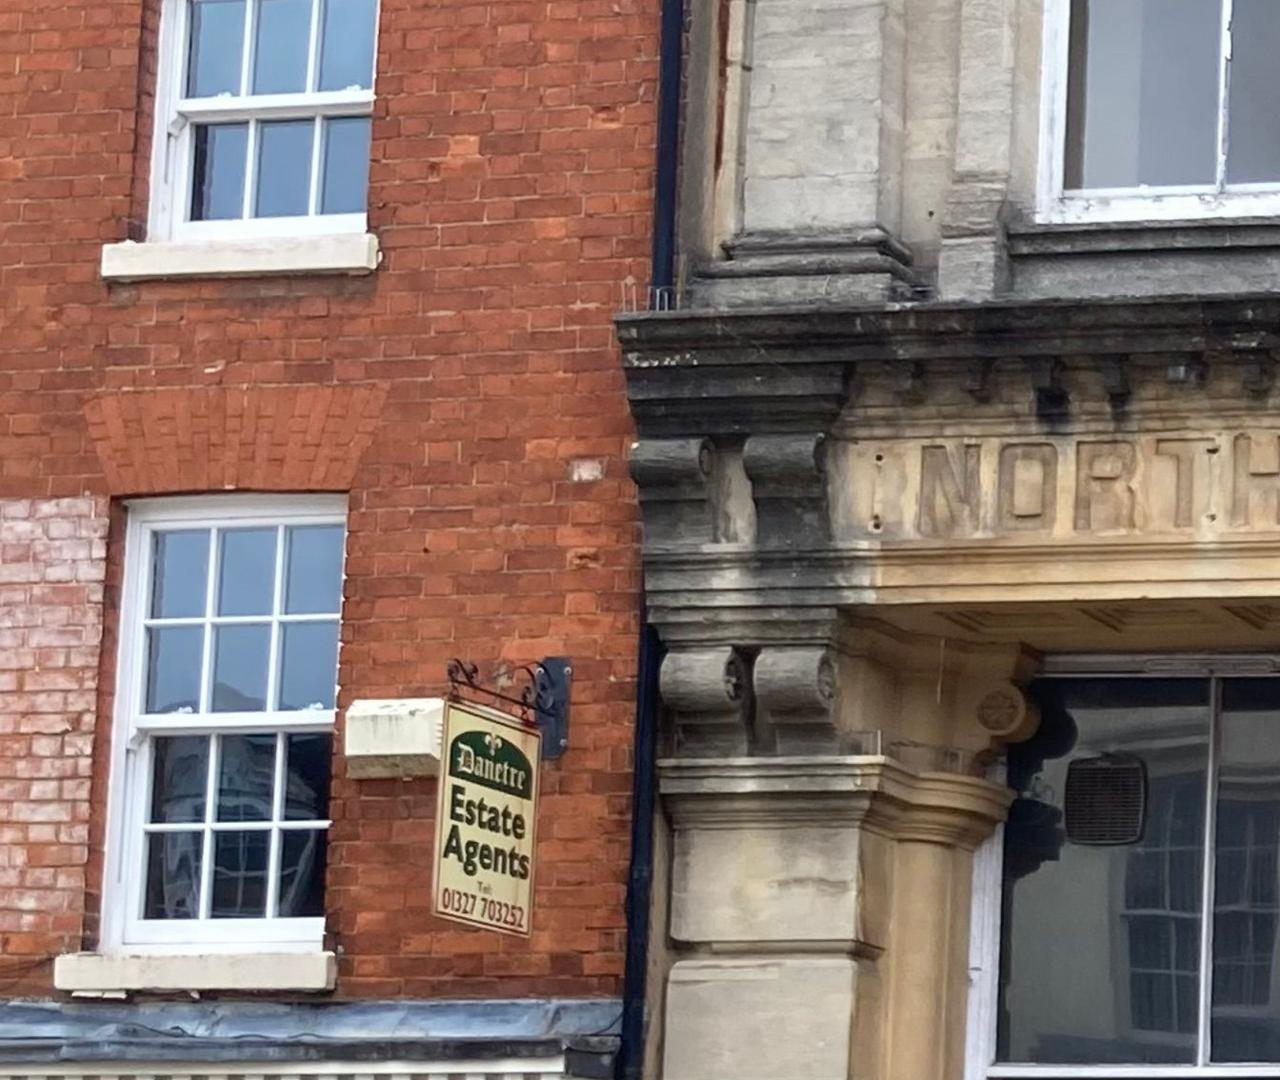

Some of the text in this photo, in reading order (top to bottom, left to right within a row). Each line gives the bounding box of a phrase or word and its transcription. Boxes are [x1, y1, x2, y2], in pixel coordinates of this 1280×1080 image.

[456, 742, 527, 791] Danetre
[449, 784, 526, 839] Estate
[443, 824, 530, 880] Agents
[442, 887, 525, 929] 01327 703252
